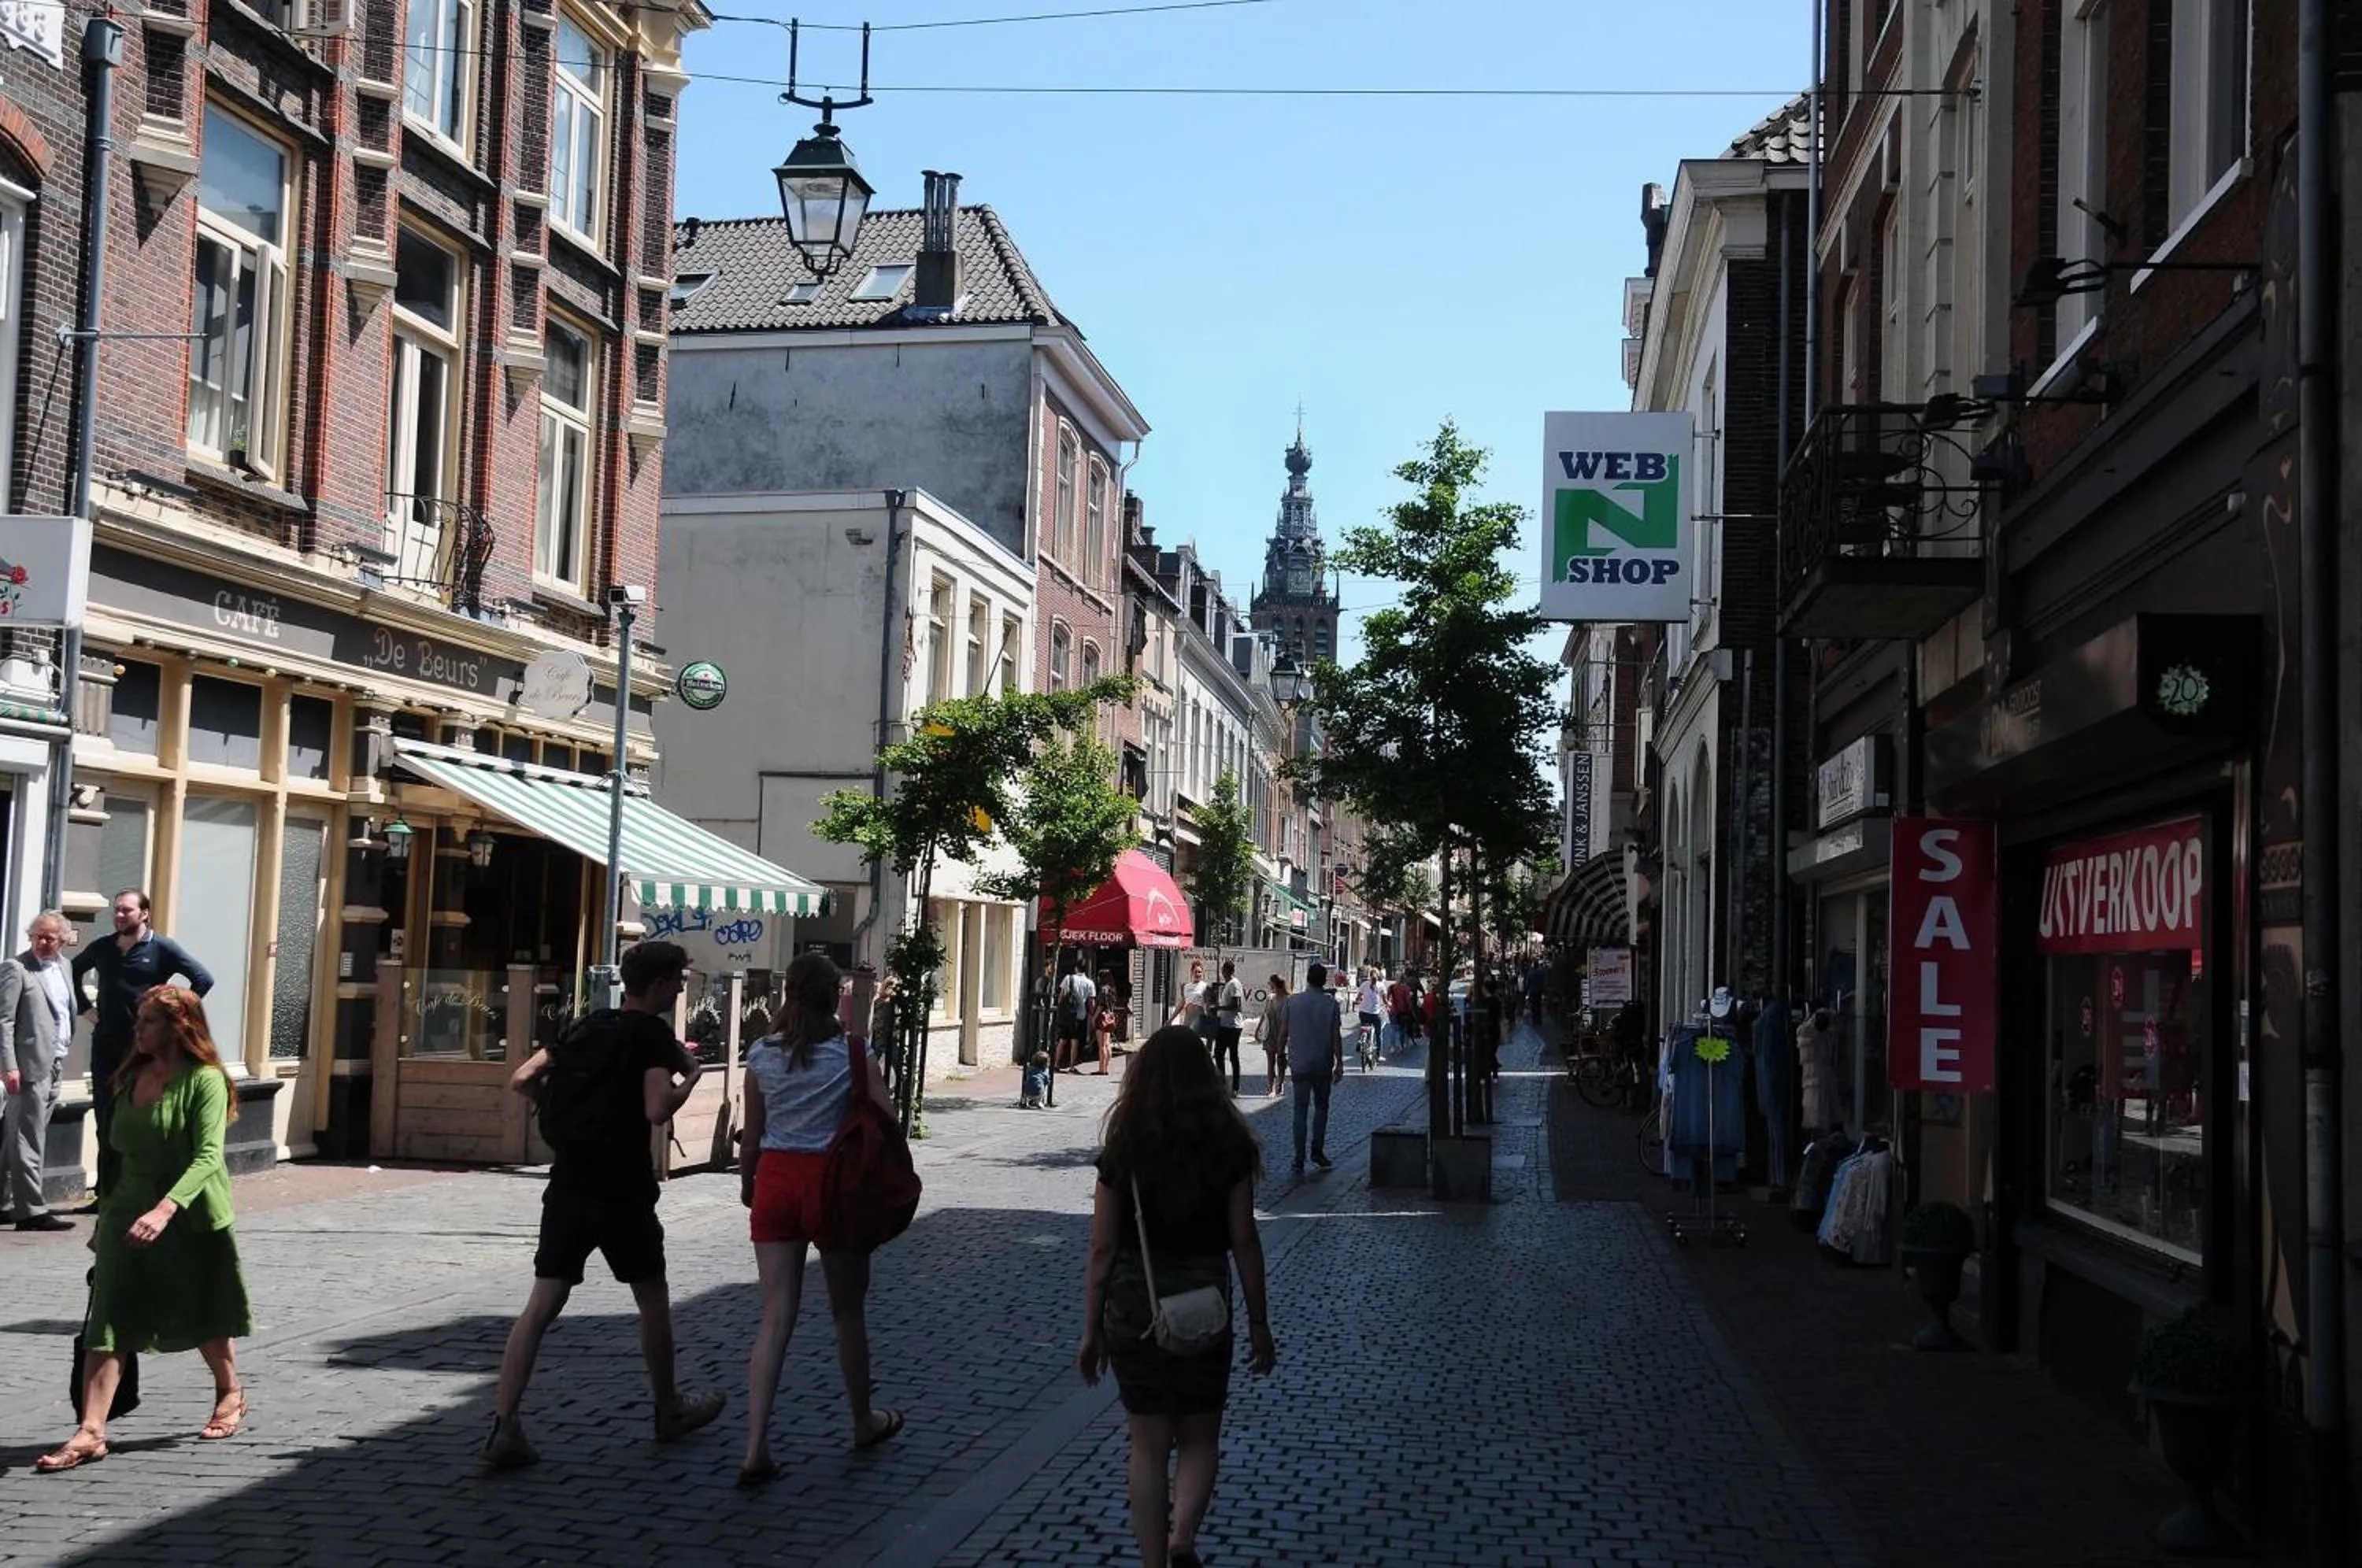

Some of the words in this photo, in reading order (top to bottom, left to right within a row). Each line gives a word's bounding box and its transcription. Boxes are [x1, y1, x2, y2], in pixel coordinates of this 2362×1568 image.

[1558, 451, 1667, 480] WEB
[1568, 558, 1680, 585] SHOP
[214, 590, 280, 638] CAFÉ
[2168, 676, 2199, 704] 20
[1575, 754, 1591, 819] JANSSEN
[1575, 824, 1588, 834] &
[2038, 837, 2203, 938] UITVERKOOP
[1089, 931, 1124, 942] FLOOR
[1914, 828, 1971, 1082] SALE
